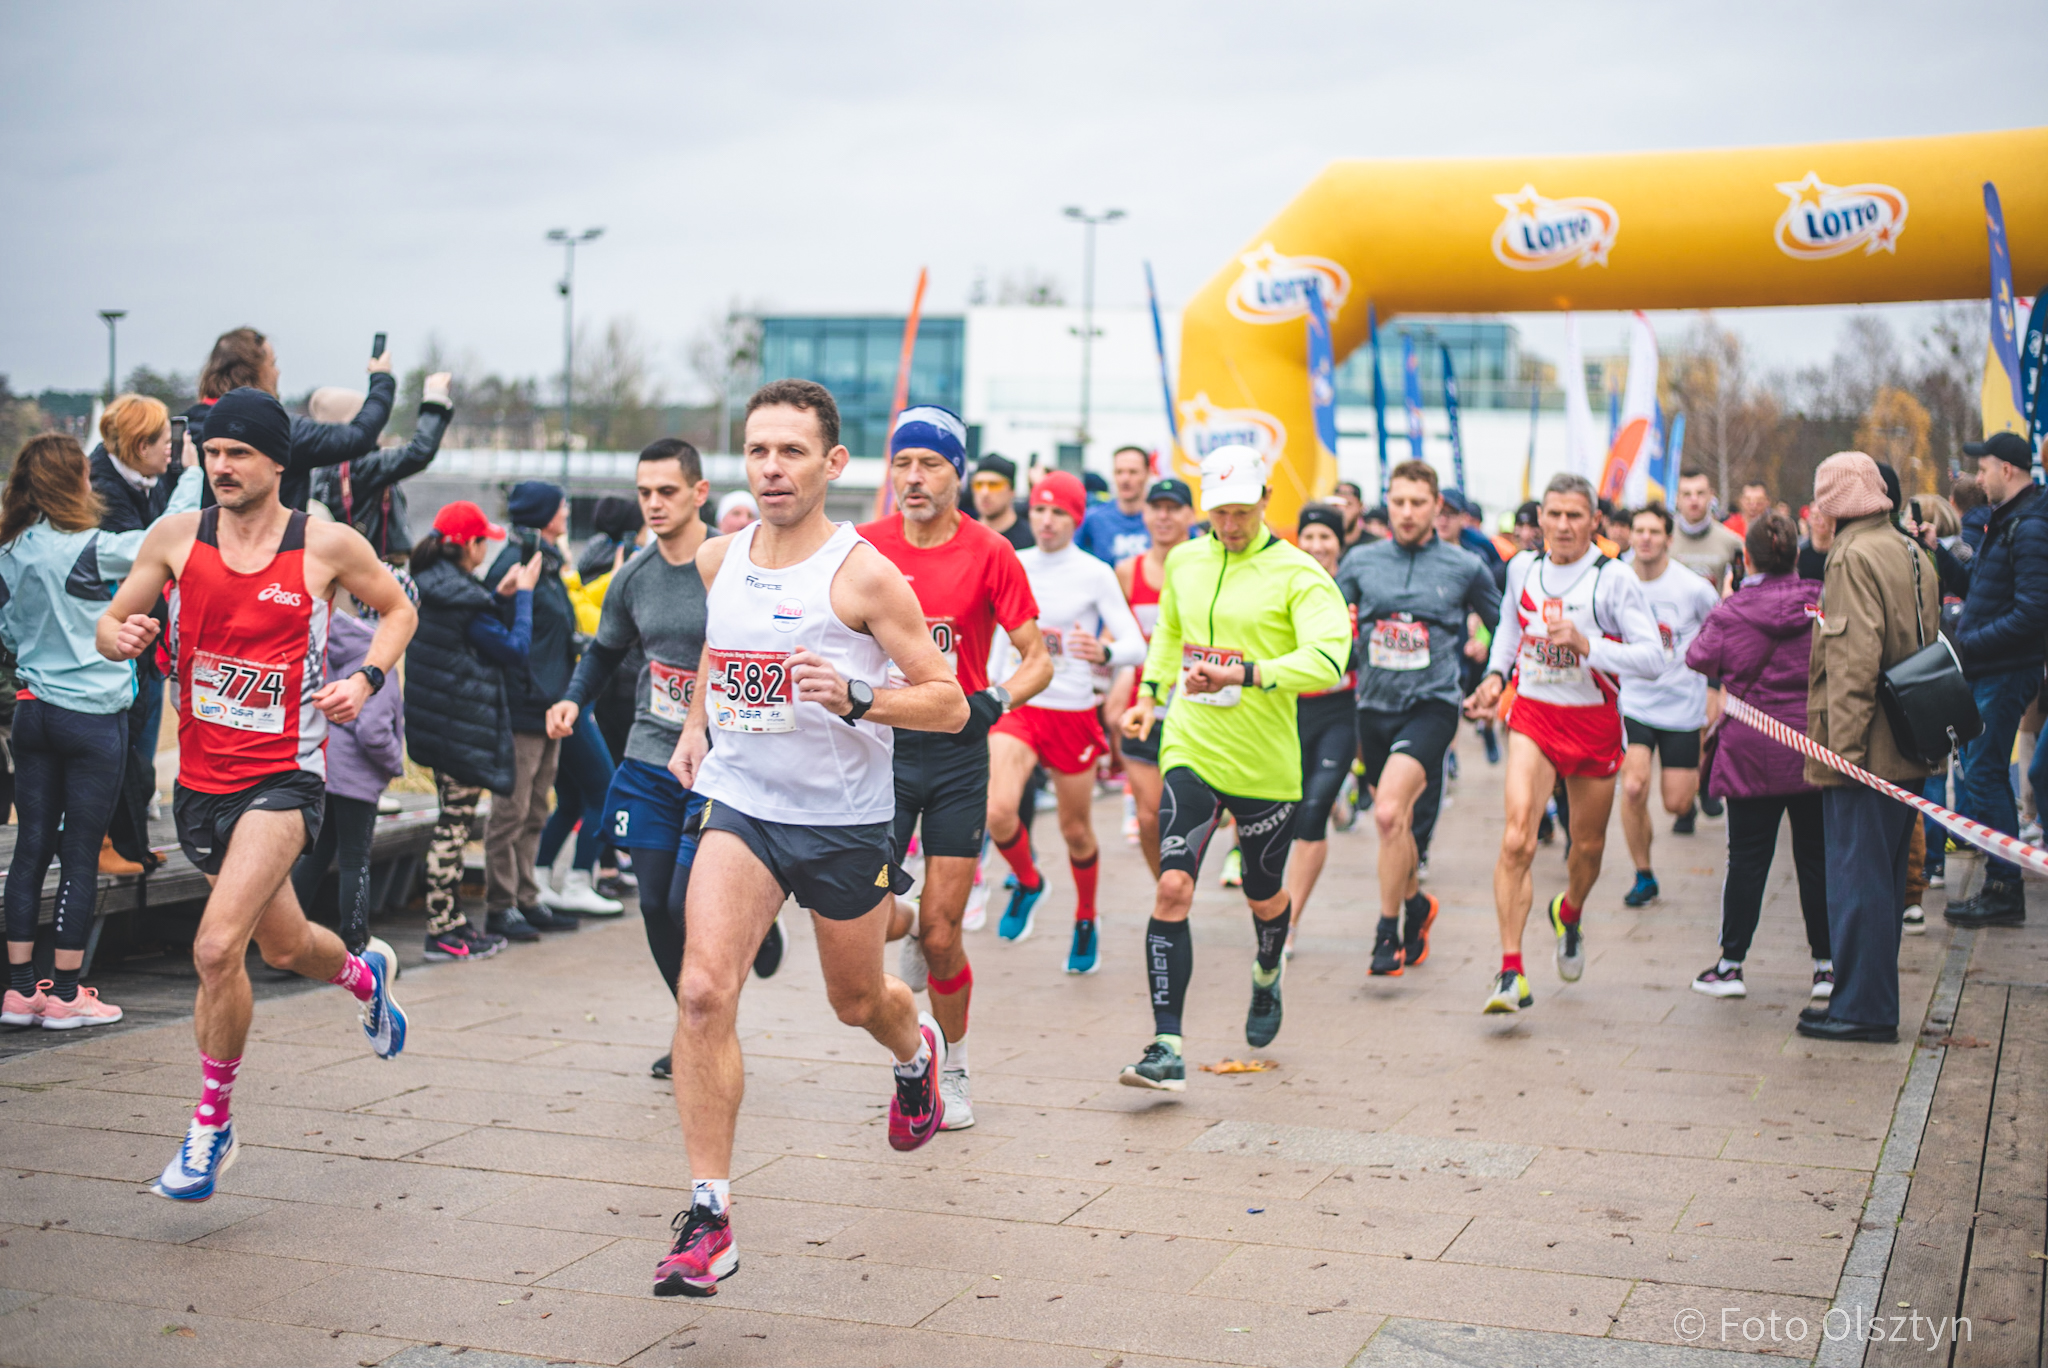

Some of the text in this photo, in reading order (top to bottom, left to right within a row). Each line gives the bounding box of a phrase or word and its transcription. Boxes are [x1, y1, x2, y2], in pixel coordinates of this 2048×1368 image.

[1522, 215, 1590, 251] LOTTO
[1805, 201, 1878, 240] LOTTO
[217, 663, 286, 708] 774
[725, 661, 786, 704] 582
[614, 810, 630, 837] 3
